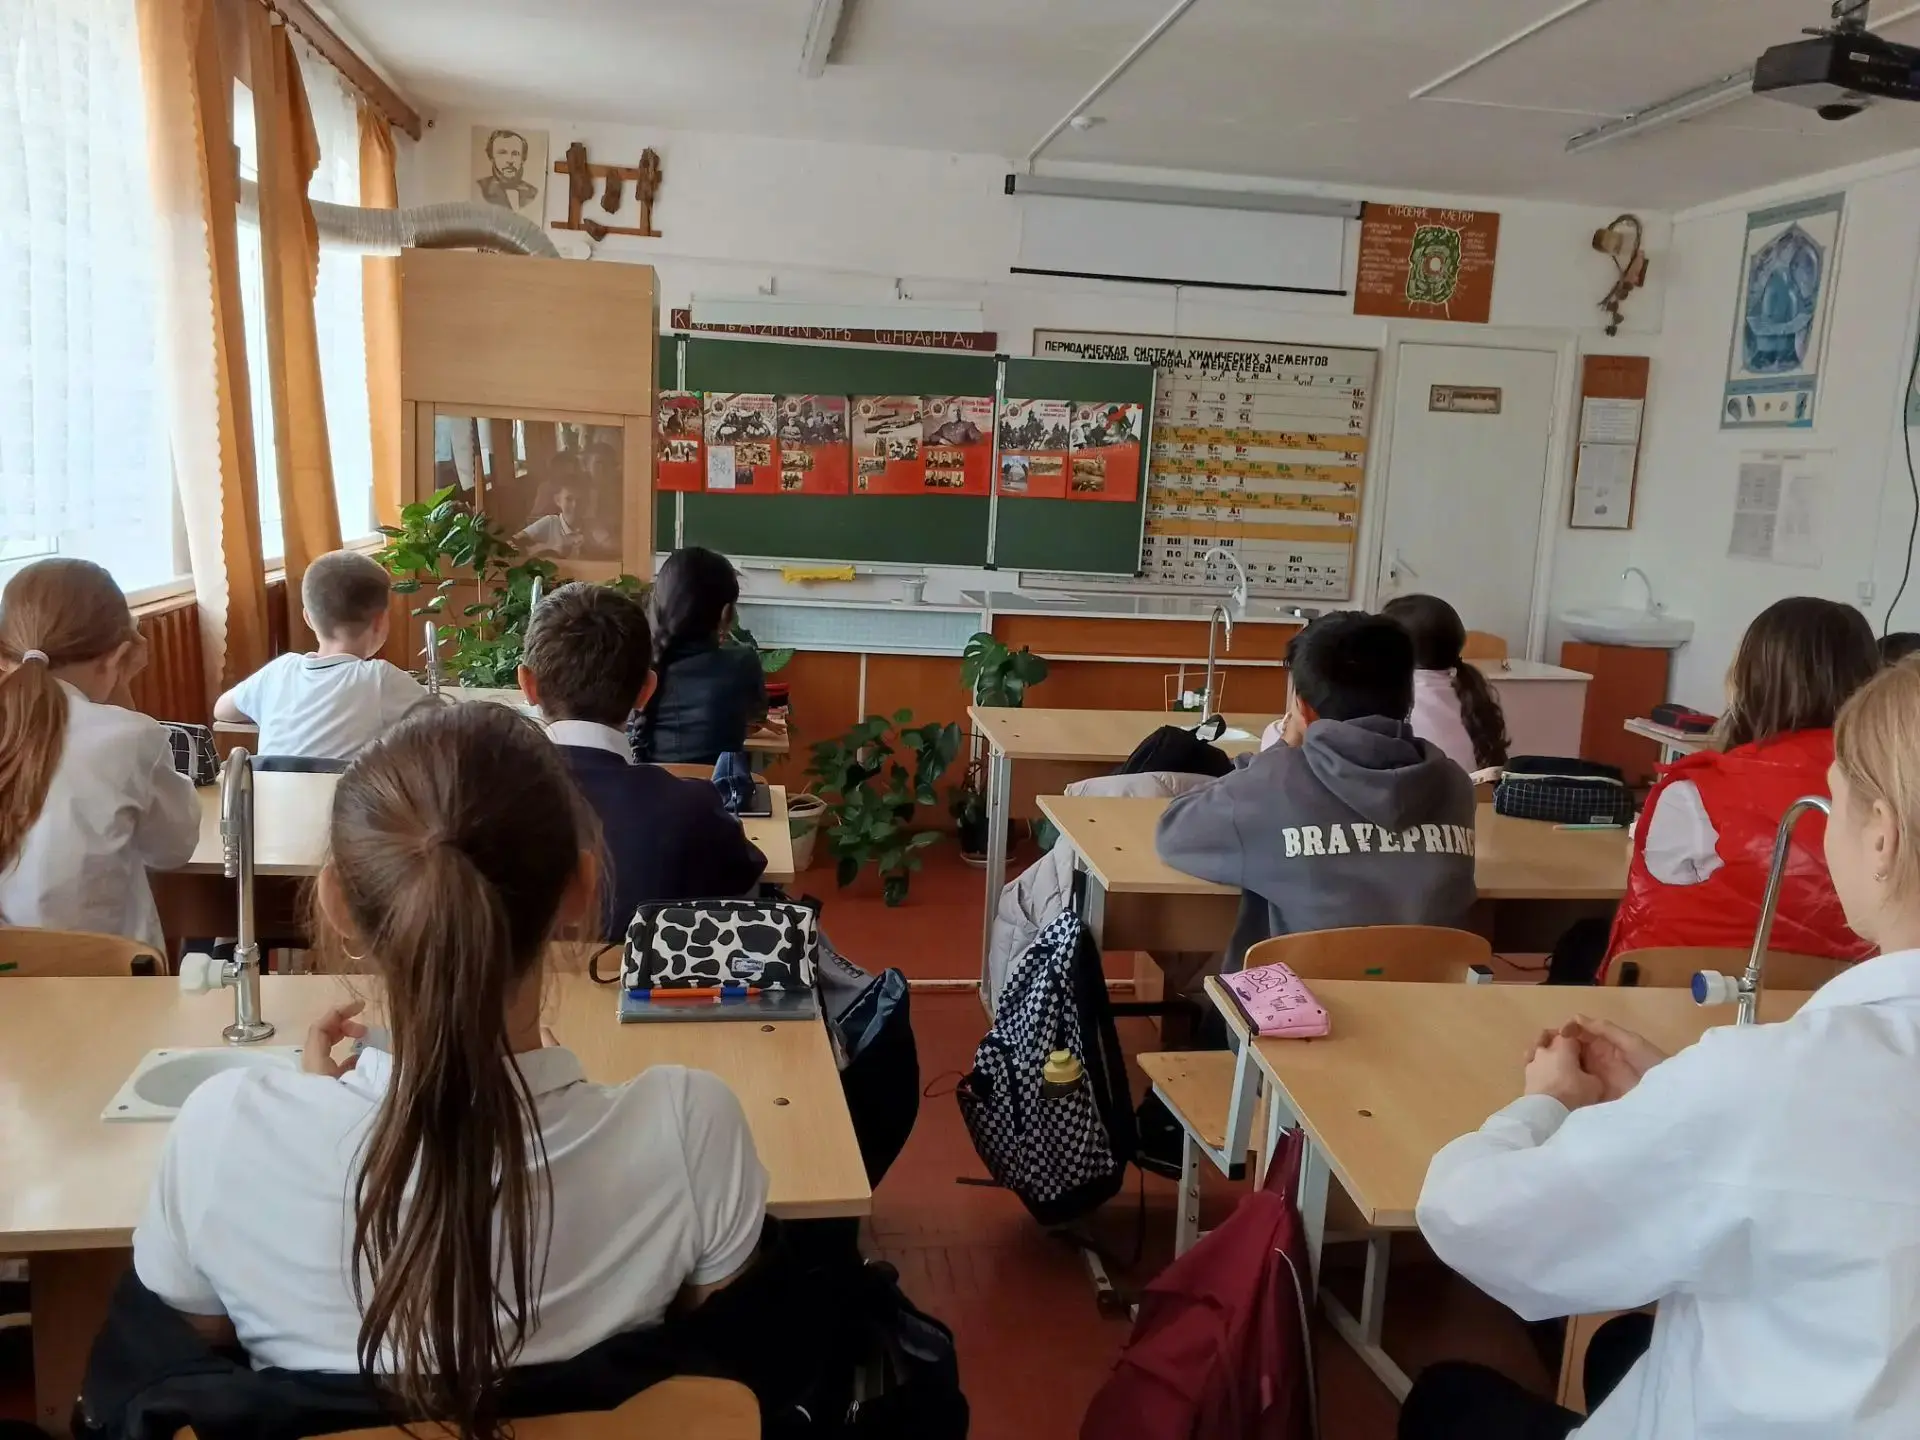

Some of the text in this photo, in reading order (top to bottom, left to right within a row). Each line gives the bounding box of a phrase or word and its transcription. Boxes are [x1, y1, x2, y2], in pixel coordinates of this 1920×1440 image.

[1387, 205, 1475, 223] СТРОЕНИЕ КЛЕТКИ
[674, 309, 687, 329] K
[952, 332, 976, 350] Au
[1044, 340, 1329, 367] ПЕРИОДИЧЕСКАЯ СИСТЕМА ХИМИЧЕСКИХ ЭЛЕМЕНТОВ
[1200, 360, 1272, 373] МЕНДЕЛЕЕВА
